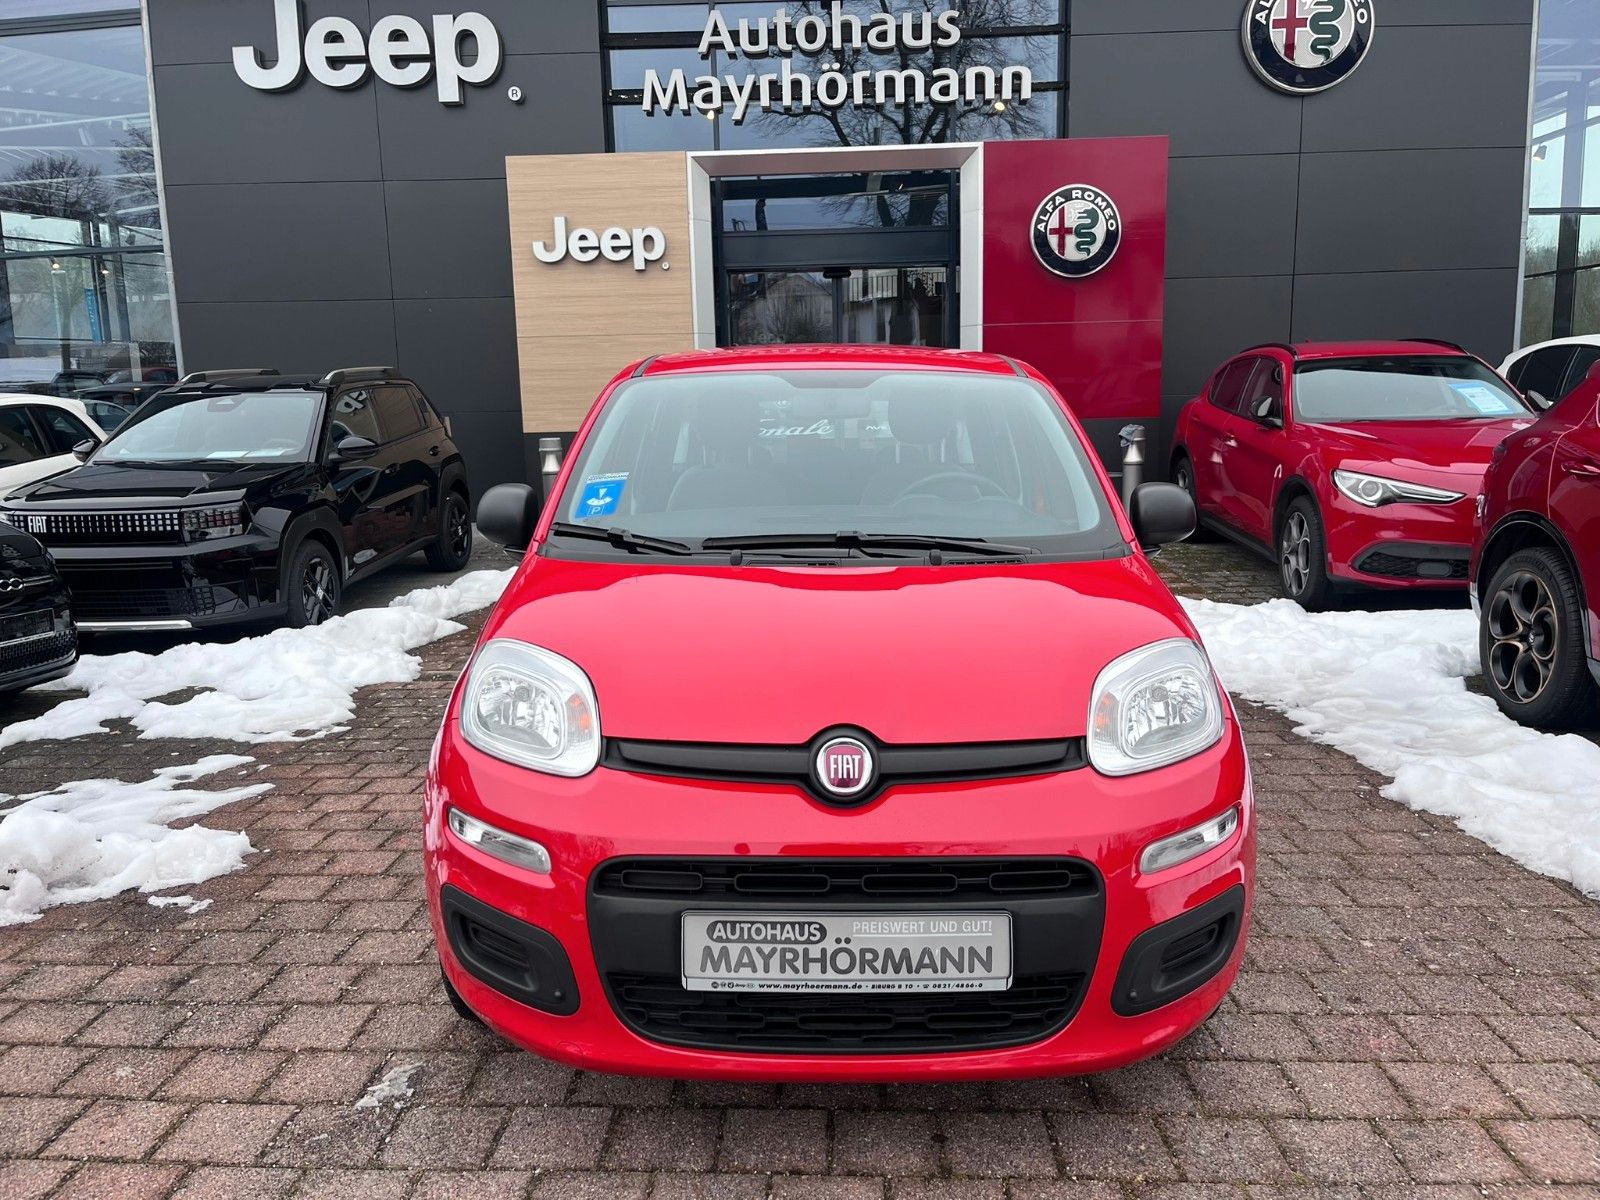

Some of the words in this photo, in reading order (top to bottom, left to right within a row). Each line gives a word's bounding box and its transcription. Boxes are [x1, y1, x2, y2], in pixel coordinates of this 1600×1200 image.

[698, 1, 961, 57] Autohaus
[232, 0, 502, 104] Jeep
[641, 60, 1032, 121] Mayrhörmann
[1036, 195, 1066, 233] ALFA
[1071, 189, 1117, 231] ROMEO
[532, 216, 666, 271] Jeep
[28, 516, 47, 533] FIAT
[829, 754, 862, 779] FIAT
[713, 922, 822, 941] AUTOHAUS
[852, 921, 926, 934] PREISWERT
[930, 920, 958, 933] UND
[962, 920, 993, 932] GUT!
[699, 936, 993, 976] MAYRHÖRMANN
